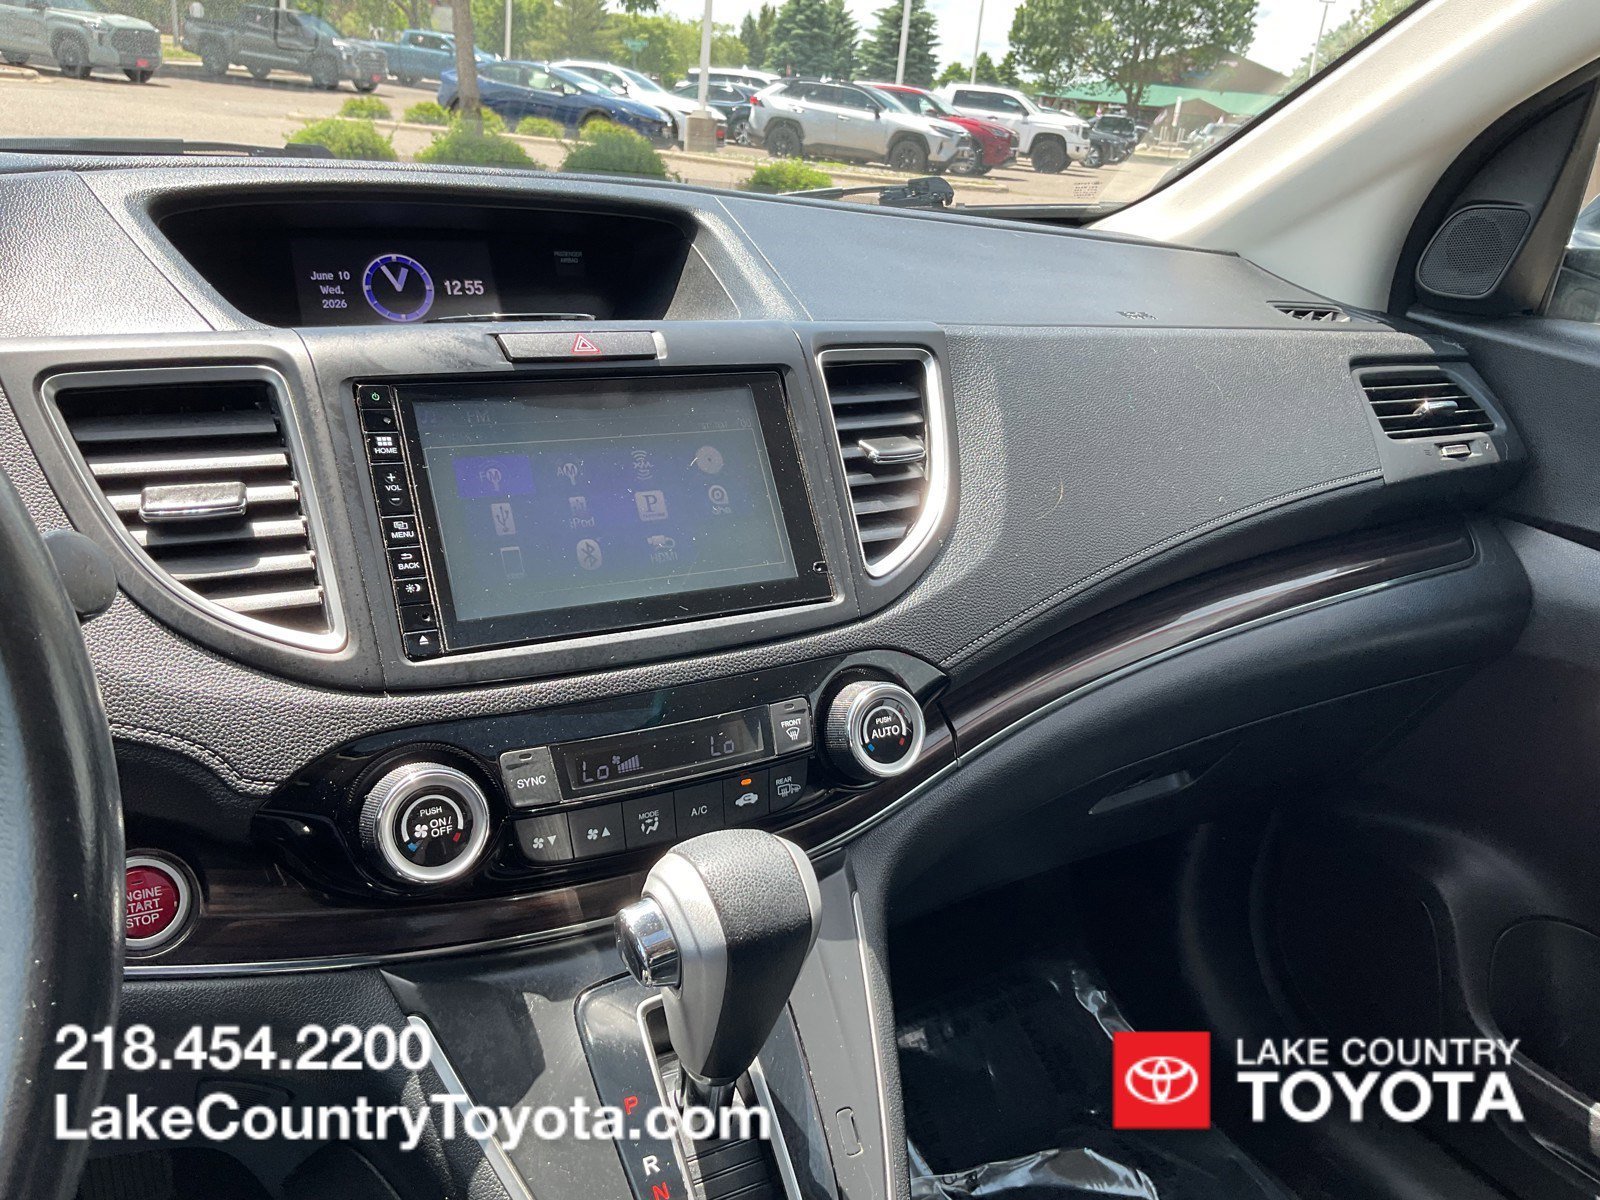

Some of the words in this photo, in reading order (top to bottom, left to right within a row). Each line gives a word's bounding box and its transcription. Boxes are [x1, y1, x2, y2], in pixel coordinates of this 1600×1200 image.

[310, 271, 334, 280] June
[338, 271, 351, 280] 10
[319, 285, 345, 295] Wed.
[322, 299, 348, 309] 2026
[385, 484, 402, 492] VOL
[391, 531, 415, 539] MENU
[397, 562, 421, 570] BACK
[780, 718, 802, 728] FRONT
[875, 716, 892, 725] PUSH
[871, 724, 900, 739] AUTO
[517, 775, 546, 788] SYNC
[776, 777, 792, 785] REAR
[419, 805, 443, 817] PUSH
[638, 810, 659, 820] MODE
[690, 804, 708, 816] A/C
[431, 825, 453, 837] OFF
[126, 886, 163, 901] NGINE
[126, 898, 160, 914] TART
[126, 913, 160, 928] STOP
[623, 1095, 638, 1115] P
[643, 1155, 661, 1176] R
[651, 1182, 670, 1200] N
